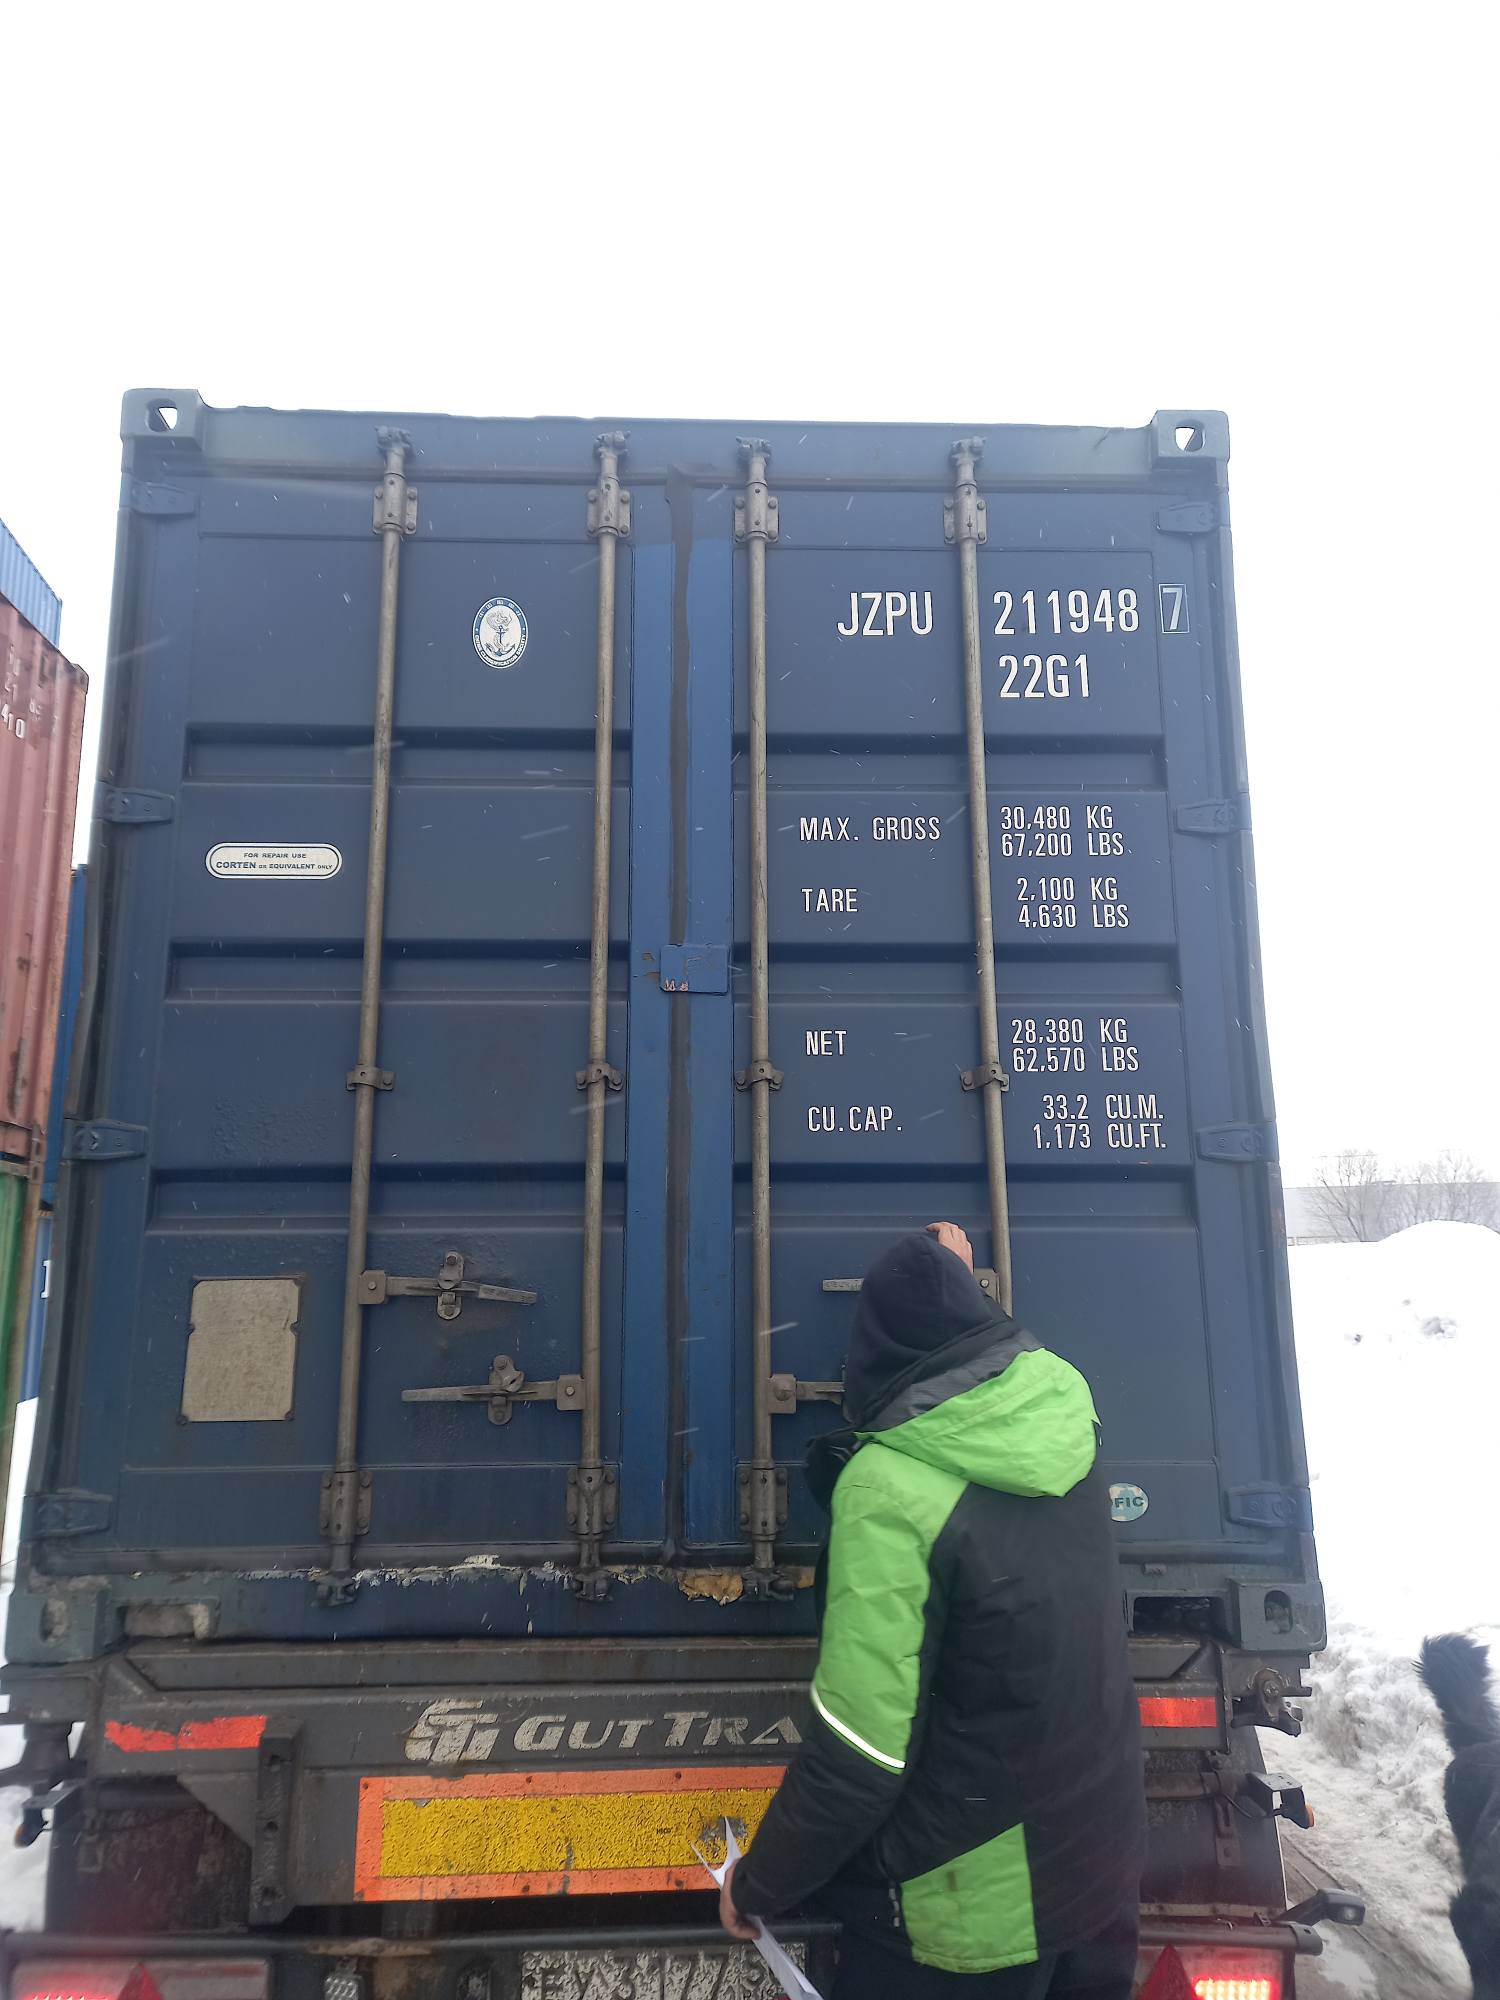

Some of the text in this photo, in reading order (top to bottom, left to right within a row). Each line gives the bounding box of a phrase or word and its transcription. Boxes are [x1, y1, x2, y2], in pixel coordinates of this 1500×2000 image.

[836, 587, 1185, 636] JZPU 211948 7
[999, 654, 1090, 699] 22G1
[800, 817, 860, 841] MAX.
[872, 816, 941, 840] GROSS
[1086, 805, 1114, 830] KG
[1001, 832, 1124, 857] 67,200 LBS
[216, 861, 256, 869] CORTEN
[801, 888, 859, 913] TARE
[1090, 877, 1118, 901] KG
[1018, 904, 1129, 929] 4,630 LBS
[806, 1030, 848, 1056] NET
[1099, 1018, 1127, 1043] KG
[1012, 1046, 1140, 1072] 62,570 LBS
[807, 1094, 1164, 1132] CU.CAP. 33.2 CU.M.
[1033, 1122, 1168, 1149] 1,173 CU.FT.
[1113, 1496, 1144, 1508] FIC
[663, 1710, 803, 1748] TRA
